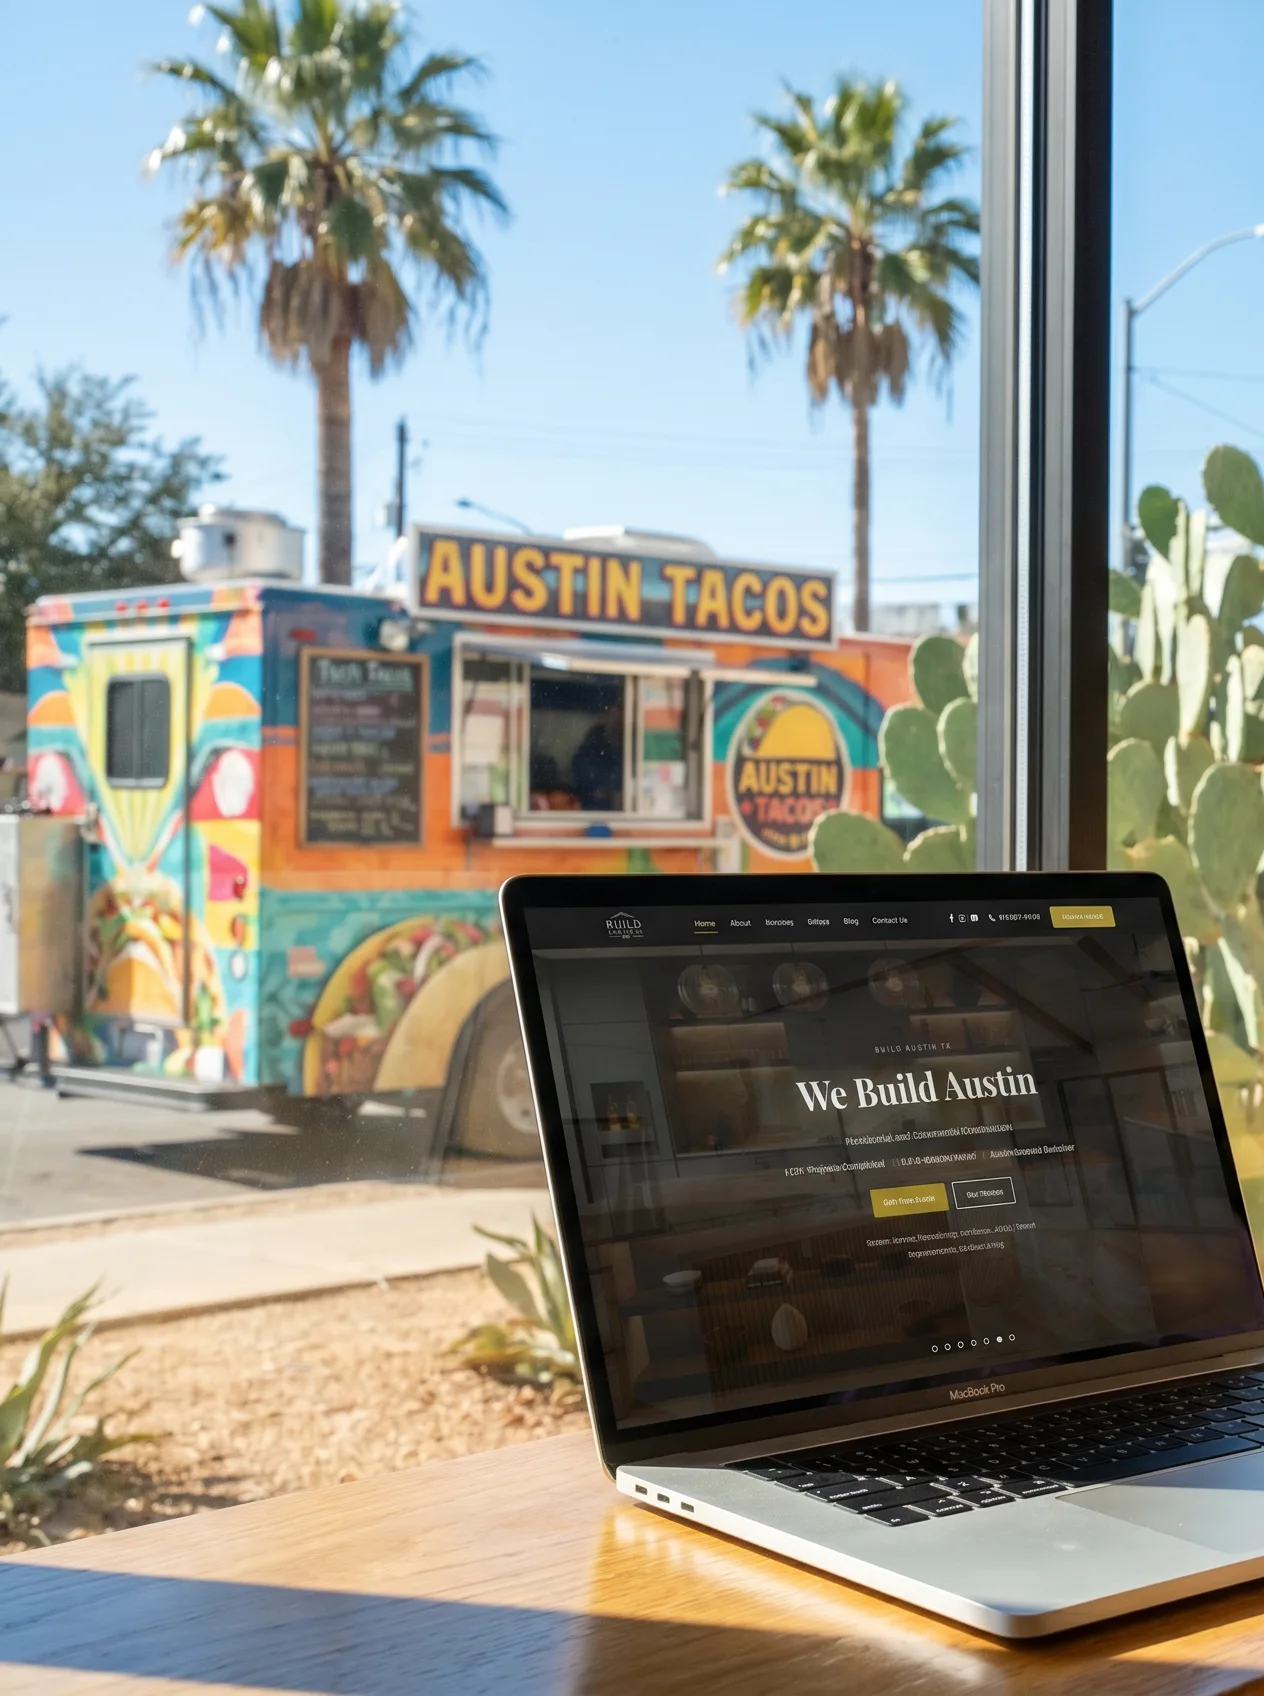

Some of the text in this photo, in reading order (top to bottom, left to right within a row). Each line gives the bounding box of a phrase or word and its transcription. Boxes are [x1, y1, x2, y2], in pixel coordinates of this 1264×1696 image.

[424, 538, 831, 639] AUSTIN TACOS
[738, 759, 838, 795] AUSTIN
[693, 919, 716, 927] Home
[729, 919, 752, 927] About
[843, 917, 859, 926] Blog
[871, 916, 898, 924] Contact
[796, 1065, 1039, 1112] We Build Austin
[949, 1382, 1006, 1401] MacBook Pro
